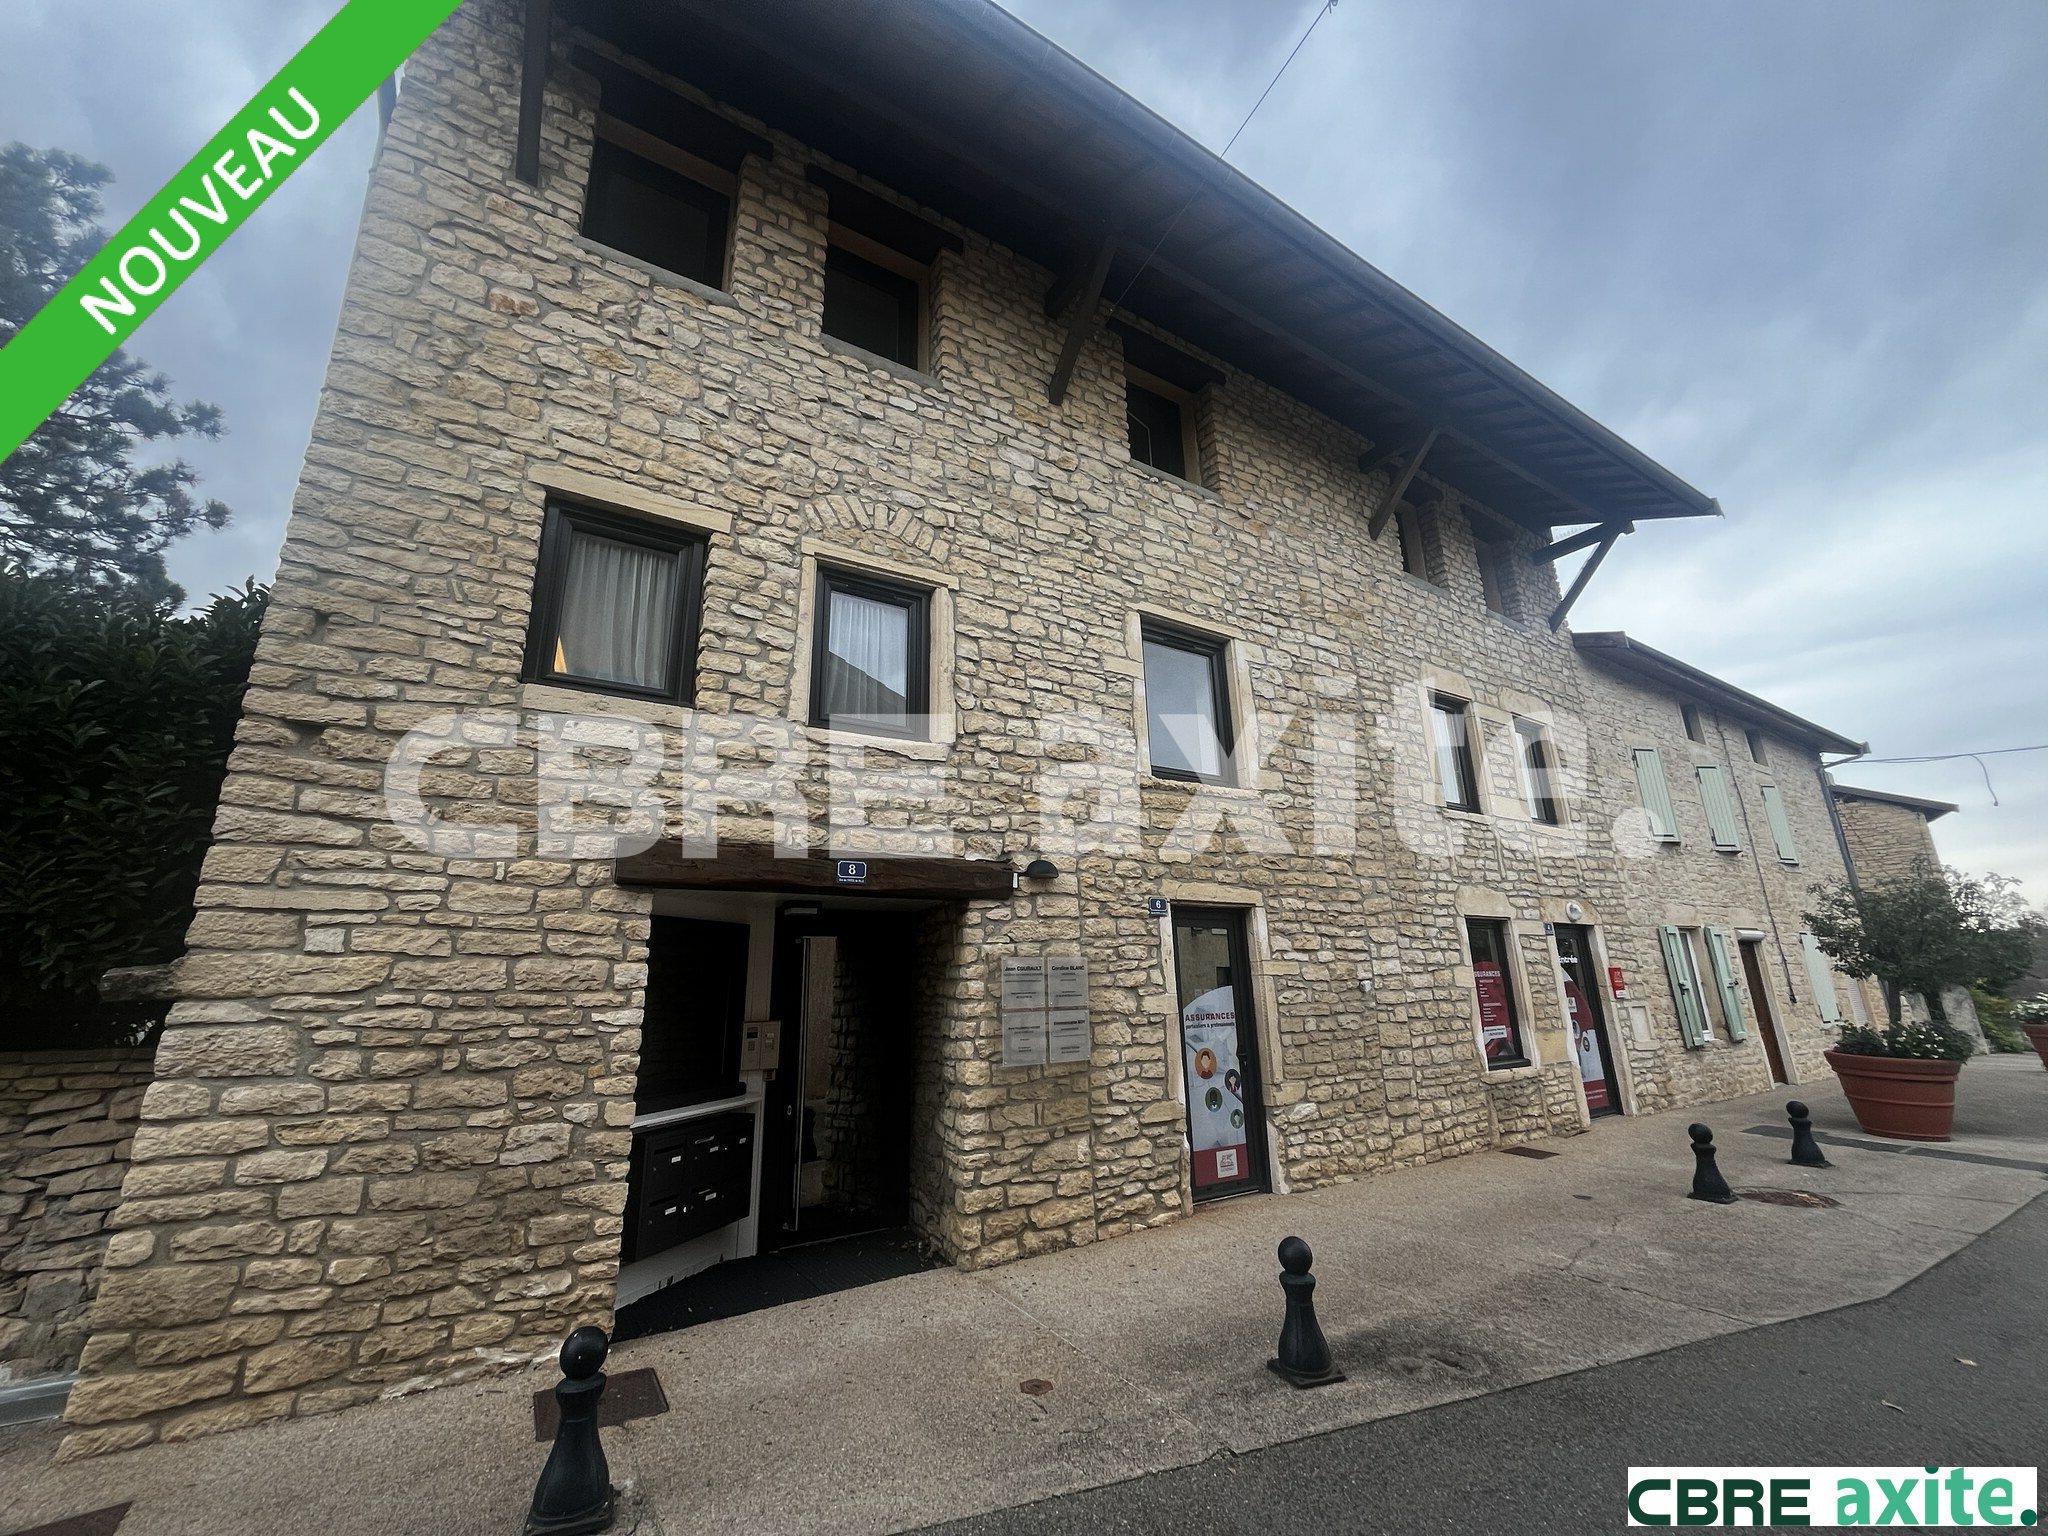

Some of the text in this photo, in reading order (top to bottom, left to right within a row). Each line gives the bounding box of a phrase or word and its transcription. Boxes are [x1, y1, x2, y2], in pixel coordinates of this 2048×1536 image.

[848, 863, 856, 875] 8
[1155, 899, 1161, 909] 6
[1184, 1011, 1235, 1022] ASSURANCES
